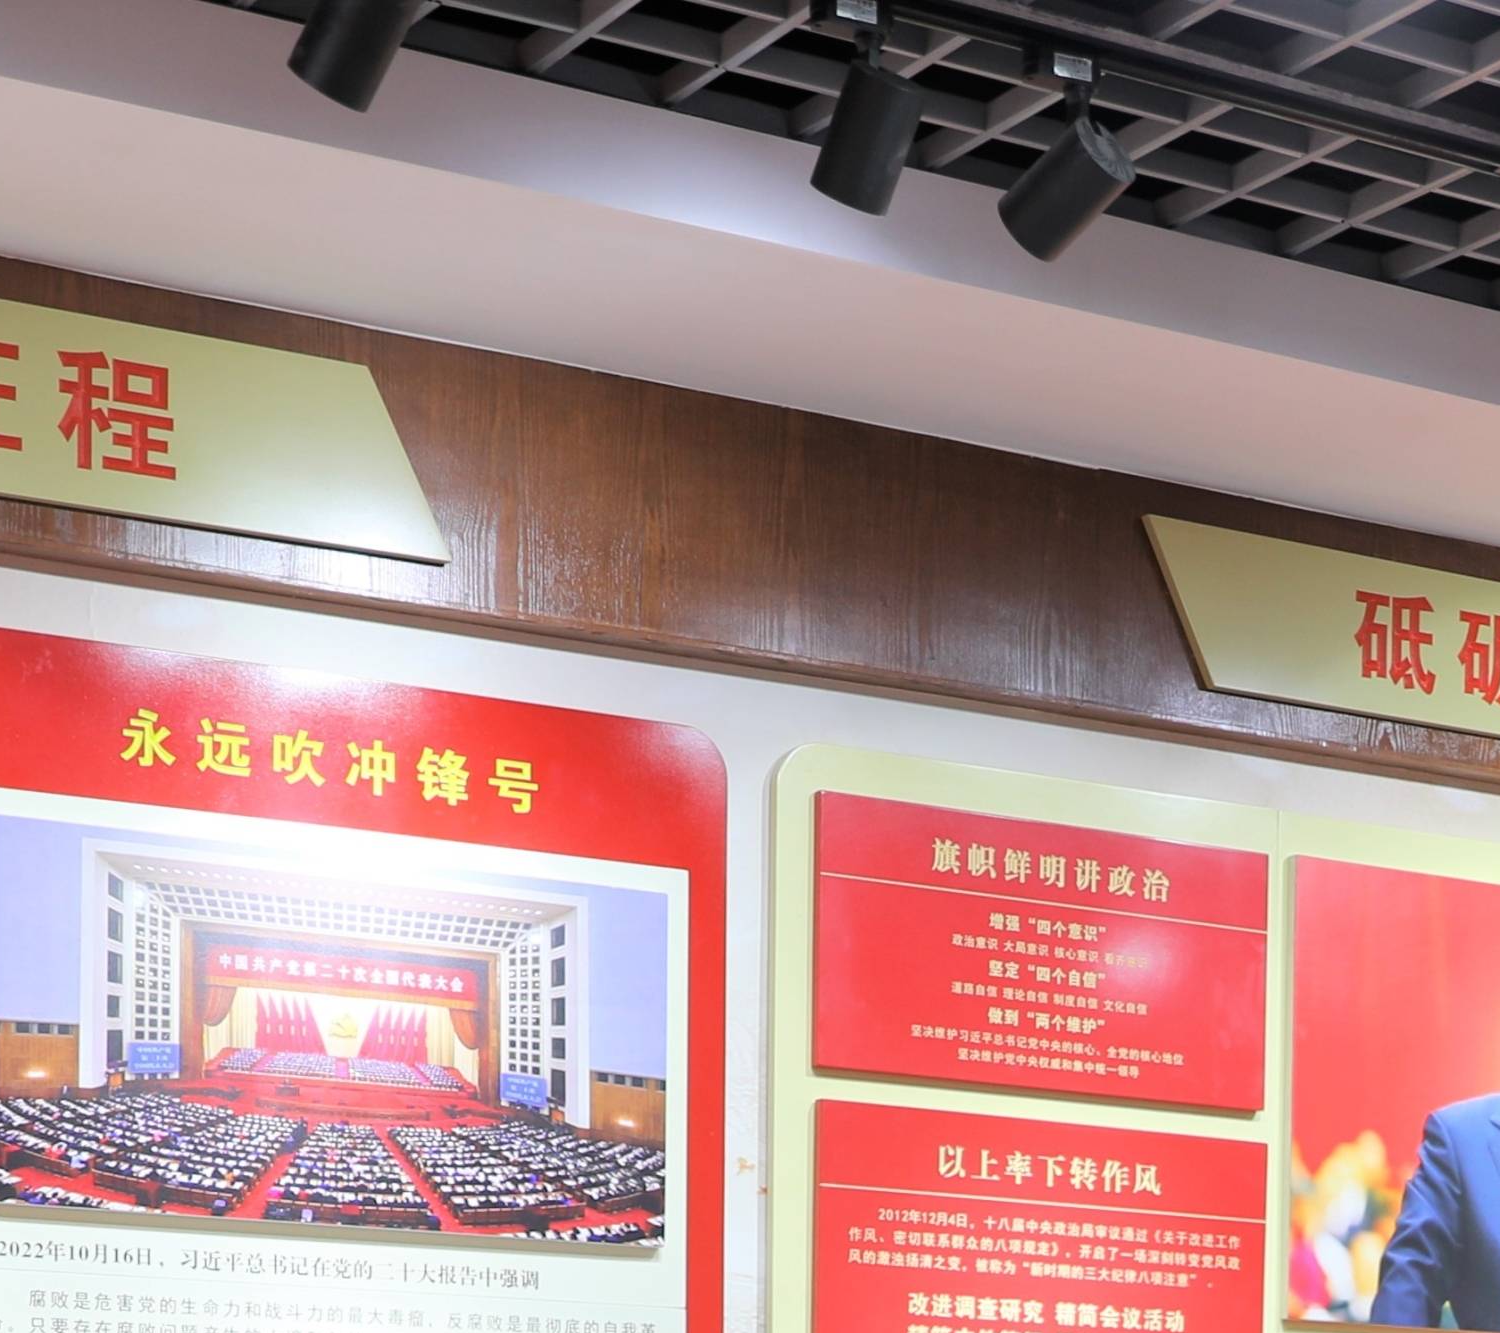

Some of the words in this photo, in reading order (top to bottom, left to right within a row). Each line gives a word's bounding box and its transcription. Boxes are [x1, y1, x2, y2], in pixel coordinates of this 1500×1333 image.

[120, 709, 541, 814] 永远吹冲锋号
[931, 836, 1171, 903] 旗帜鲜明讲政治
[987, 960, 1107, 990] 坚定“四个自信”
[936, 1143, 1162, 1197] 以上率下转作风
[907, 1292, 1045, 1326] 改进调查研究
[1054, 1301, 1186, 1333] 精简会议活动
